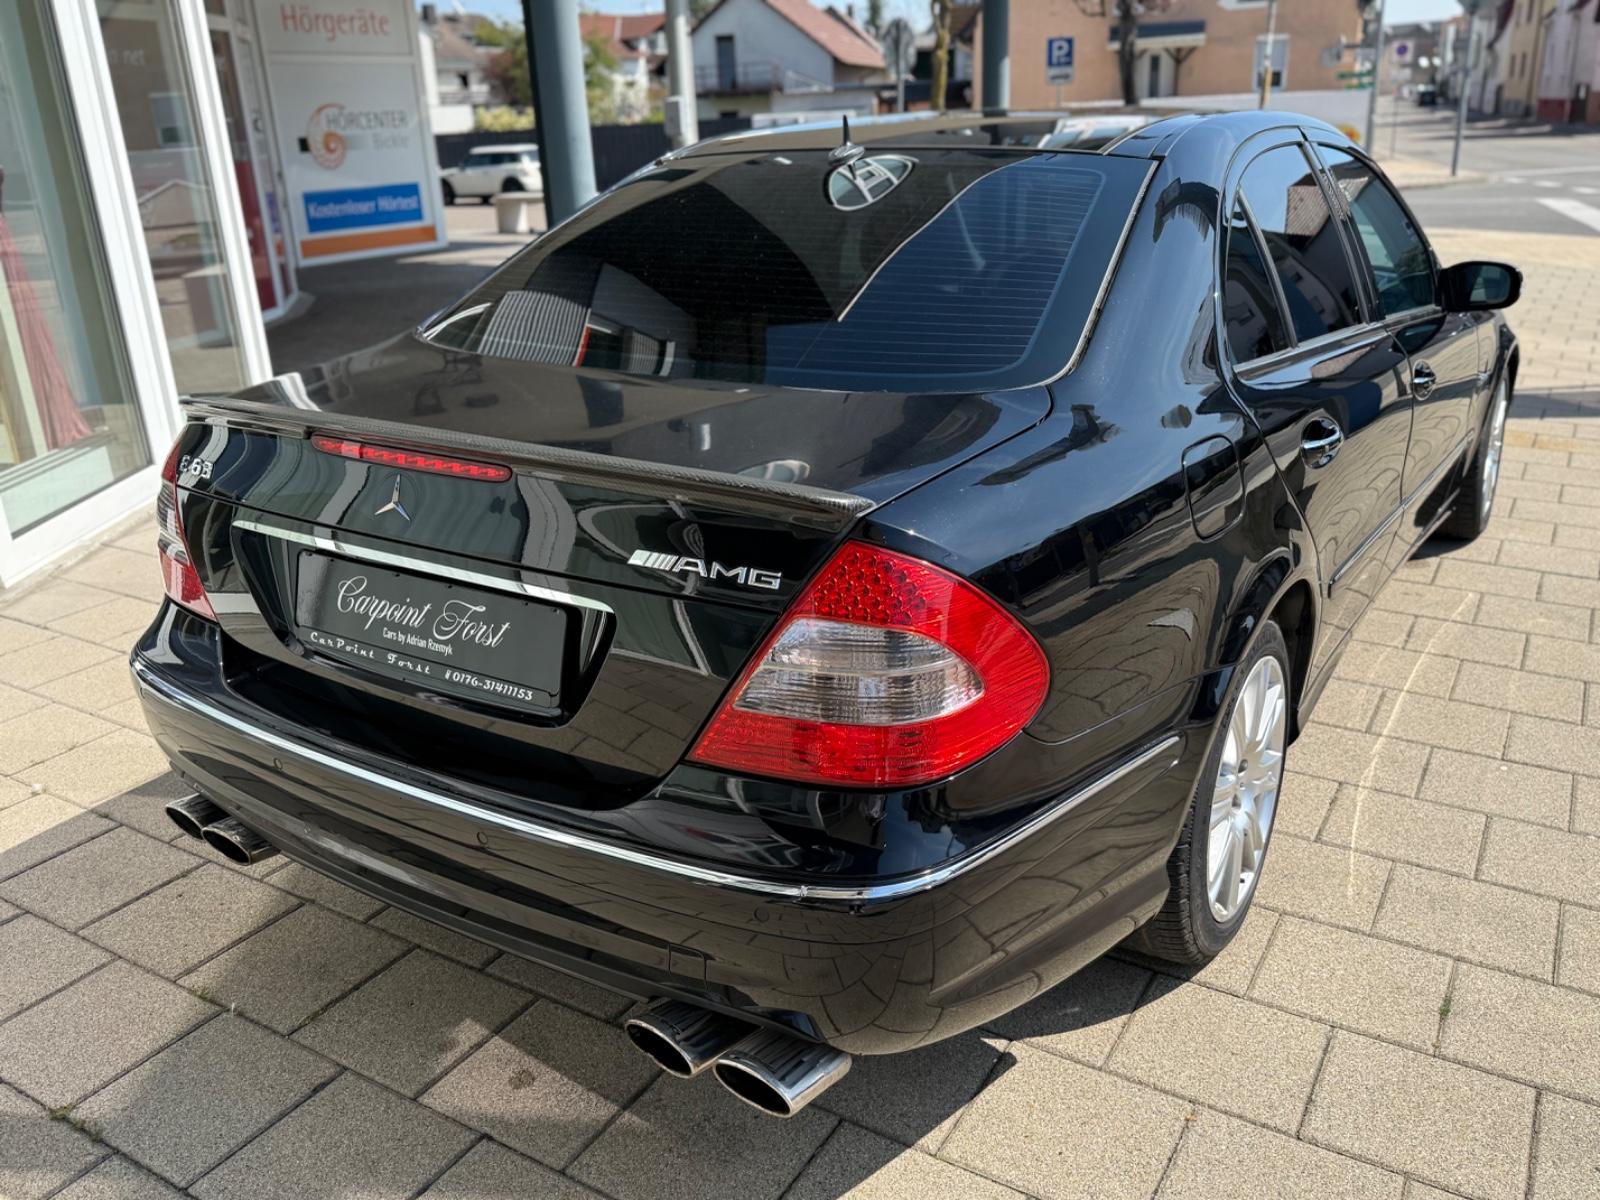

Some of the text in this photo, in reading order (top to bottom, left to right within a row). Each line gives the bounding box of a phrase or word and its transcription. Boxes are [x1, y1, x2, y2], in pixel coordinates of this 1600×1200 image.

[280, 3, 390, 42] Hörgeräte
[1052, 40, 1069, 65] P
[325, 107, 408, 130] HÖRCENTER
[672, 556, 782, 590] AMG
[337, 575, 511, 648] Carpoint Forst
[382, 627, 397, 641] Cars
[398, 631, 406, 645] by
[406, 633, 427, 649] Adrian
